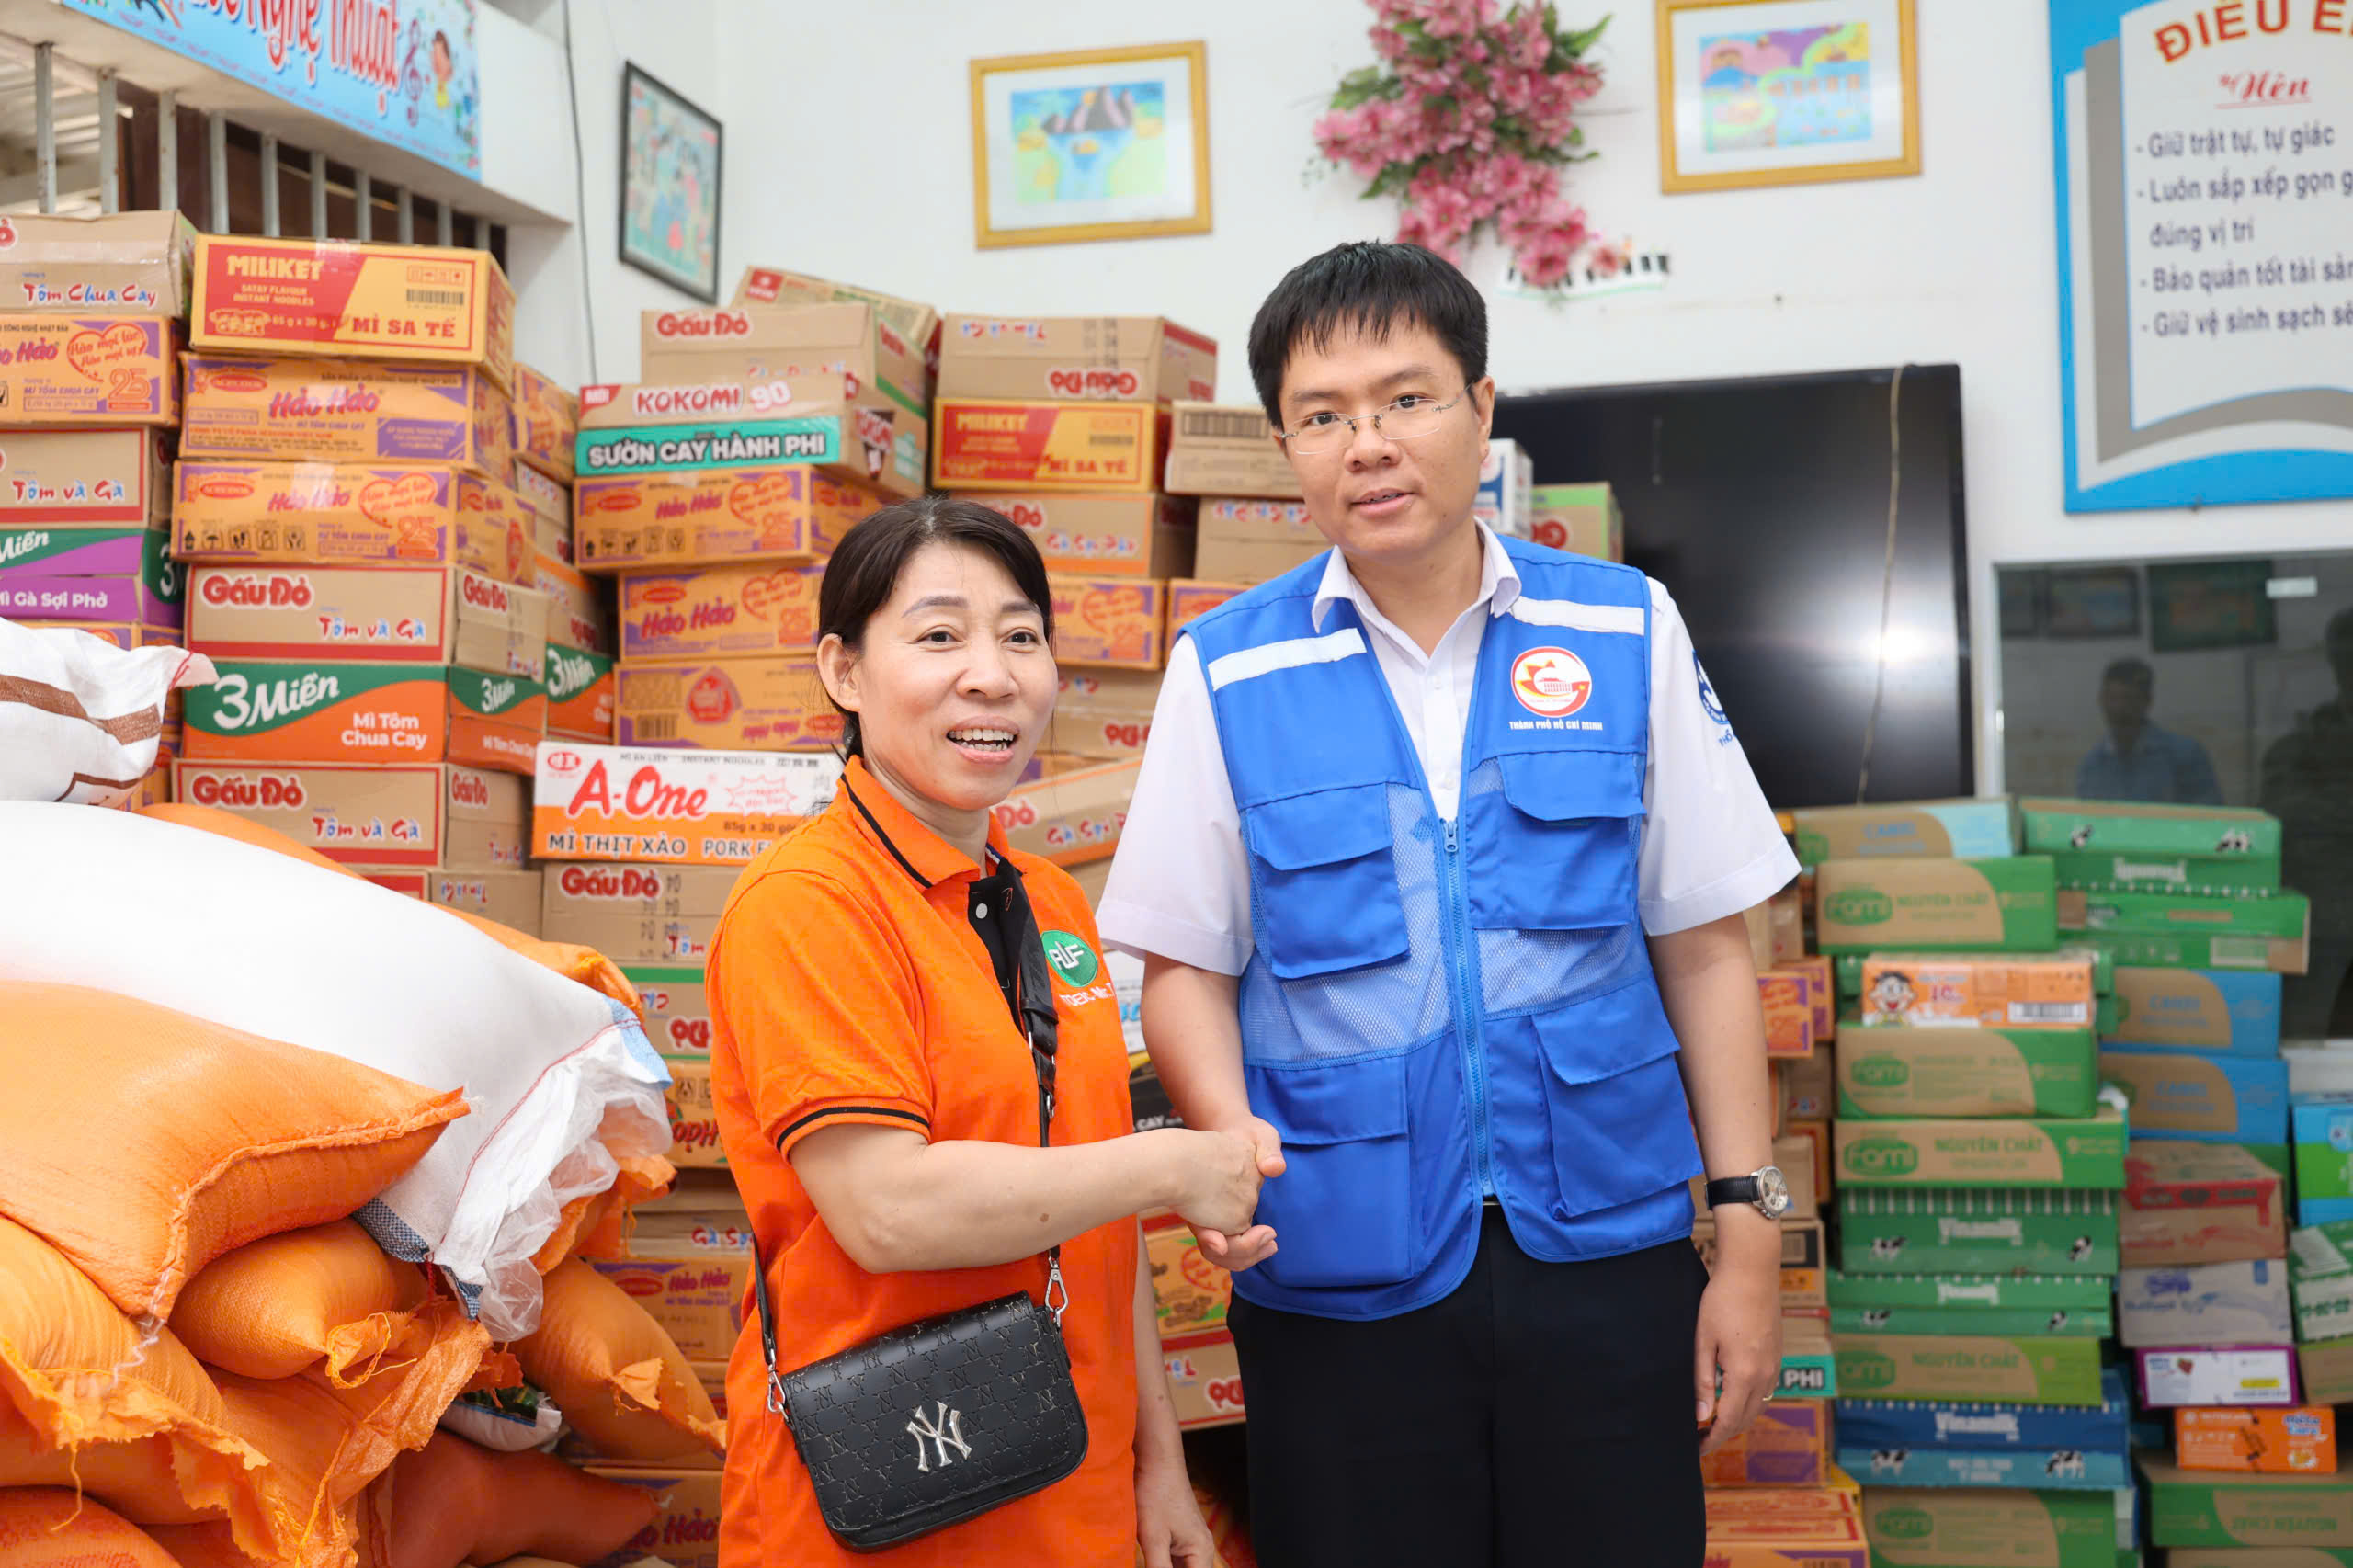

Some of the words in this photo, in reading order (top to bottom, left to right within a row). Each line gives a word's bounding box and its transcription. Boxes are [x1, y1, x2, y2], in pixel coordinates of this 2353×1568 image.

[2147, 130, 2185, 158] Giữ
[2189, 128, 2225, 158] trật
[2263, 125, 2285, 153] tự
[2290, 119, 2335, 154] giác
[2149, 175, 2200, 204] Luôn
[2208, 165, 2245, 202] sắp
[2251, 164, 2289, 201] xếp
[2294, 171, 2335, 199] gọn
[2149, 222, 2202, 252] đúng
[2208, 217, 2226, 246] vị
[2232, 216, 2255, 243] trí
[227, 254, 324, 281] MILIKET
[2152, 264, 2193, 292] Bảo
[2198, 260, 2250, 295] quản
[2256, 255, 2285, 286] tốt
[2290, 256, 2316, 284] tài
[23, 283, 63, 302] Tôm
[69, 283, 117, 302] Chua
[122, 283, 157, 309] Cay
[352, 312, 380, 334] MÌ
[387, 318, 416, 336] SA
[425, 315, 456, 339] TẾ
[656, 312, 711, 337] Gấu
[714, 310, 749, 336] Đỏ
[2153, 311, 2190, 337] Giữ
[2196, 308, 2221, 337] vệ
[2226, 306, 2270, 334] sinh
[2277, 304, 2325, 334] sạch
[17, 337, 59, 363] Hảo
[635, 386, 742, 414] KOKOMI
[749, 381, 793, 412] 90
[1050, 370, 1084, 395] Đỏ
[1086, 370, 1138, 395] Gấu
[268, 386, 322, 419] Hảo
[325, 382, 381, 414] Hảo
[588, 438, 656, 468] SƯỜN
[659, 437, 707, 465] CAY
[711, 431, 781, 460] HÀNH
[784, 432, 826, 457] PHI
[12, 480, 55, 501] Tôm
[63, 480, 86, 500] và
[95, 480, 125, 501] Gà
[655, 495, 688, 520] Hảo
[690, 490, 722, 514] Hảo
[14, 591, 38, 607] Gà
[41, 592, 67, 610] Sợi
[72, 592, 108, 608] Phở
[202, 574, 267, 606] Gấu
[269, 575, 312, 607] Đỏ
[463, 574, 490, 609] Gấu
[491, 583, 508, 613] Đỏ
[319, 617, 358, 637] Tôm
[368, 617, 388, 638] và
[396, 619, 425, 638] Gà
[641, 606, 686, 639] Hảo
[690, 597, 737, 630] Hảo
[546, 648, 566, 697] 3
[213, 673, 251, 729] 3
[245, 671, 340, 728] Miền
[481, 678, 494, 713] 3
[353, 713, 376, 729] Mì
[379, 713, 419, 729] Tôm
[1508, 721, 1534, 731] THÀNH
[1536, 719, 1551, 730] PHỐ
[1553, 719, 1563, 730] HỒ
[1565, 719, 1580, 730] CHÍ
[1582, 721, 1604, 731] MINH
[341, 730, 389, 746] Chua
[392, 731, 427, 750] Cay
[191, 775, 256, 806] Gấu
[260, 776, 303, 807] Đỏ
[451, 771, 472, 802] Gấu
[472, 776, 488, 806] Đỏ
[568, 758, 708, 817] A-One
[312, 816, 354, 838] Tôm
[361, 817, 382, 838] và
[391, 818, 419, 841] Gà
[549, 827, 575, 852] MÌ
[583, 835, 635, 858] THỊT
[641, 832, 686, 856] XÀO
[704, 840, 751, 858] PORK
[760, 823, 776, 833] 30
[561, 866, 620, 896] Gấu
[621, 869, 661, 898] Đỏ
[667, 934, 705, 954] Tôm
[1136, 1114, 1165, 1130] CAY
[691, 1226, 718, 1246] Gà
[668, 1271, 699, 1292] Hảo
[700, 1267, 732, 1290] Hảo
[1784, 1368, 1824, 1390] PHI
[663, 1507, 718, 1545] Hảo
